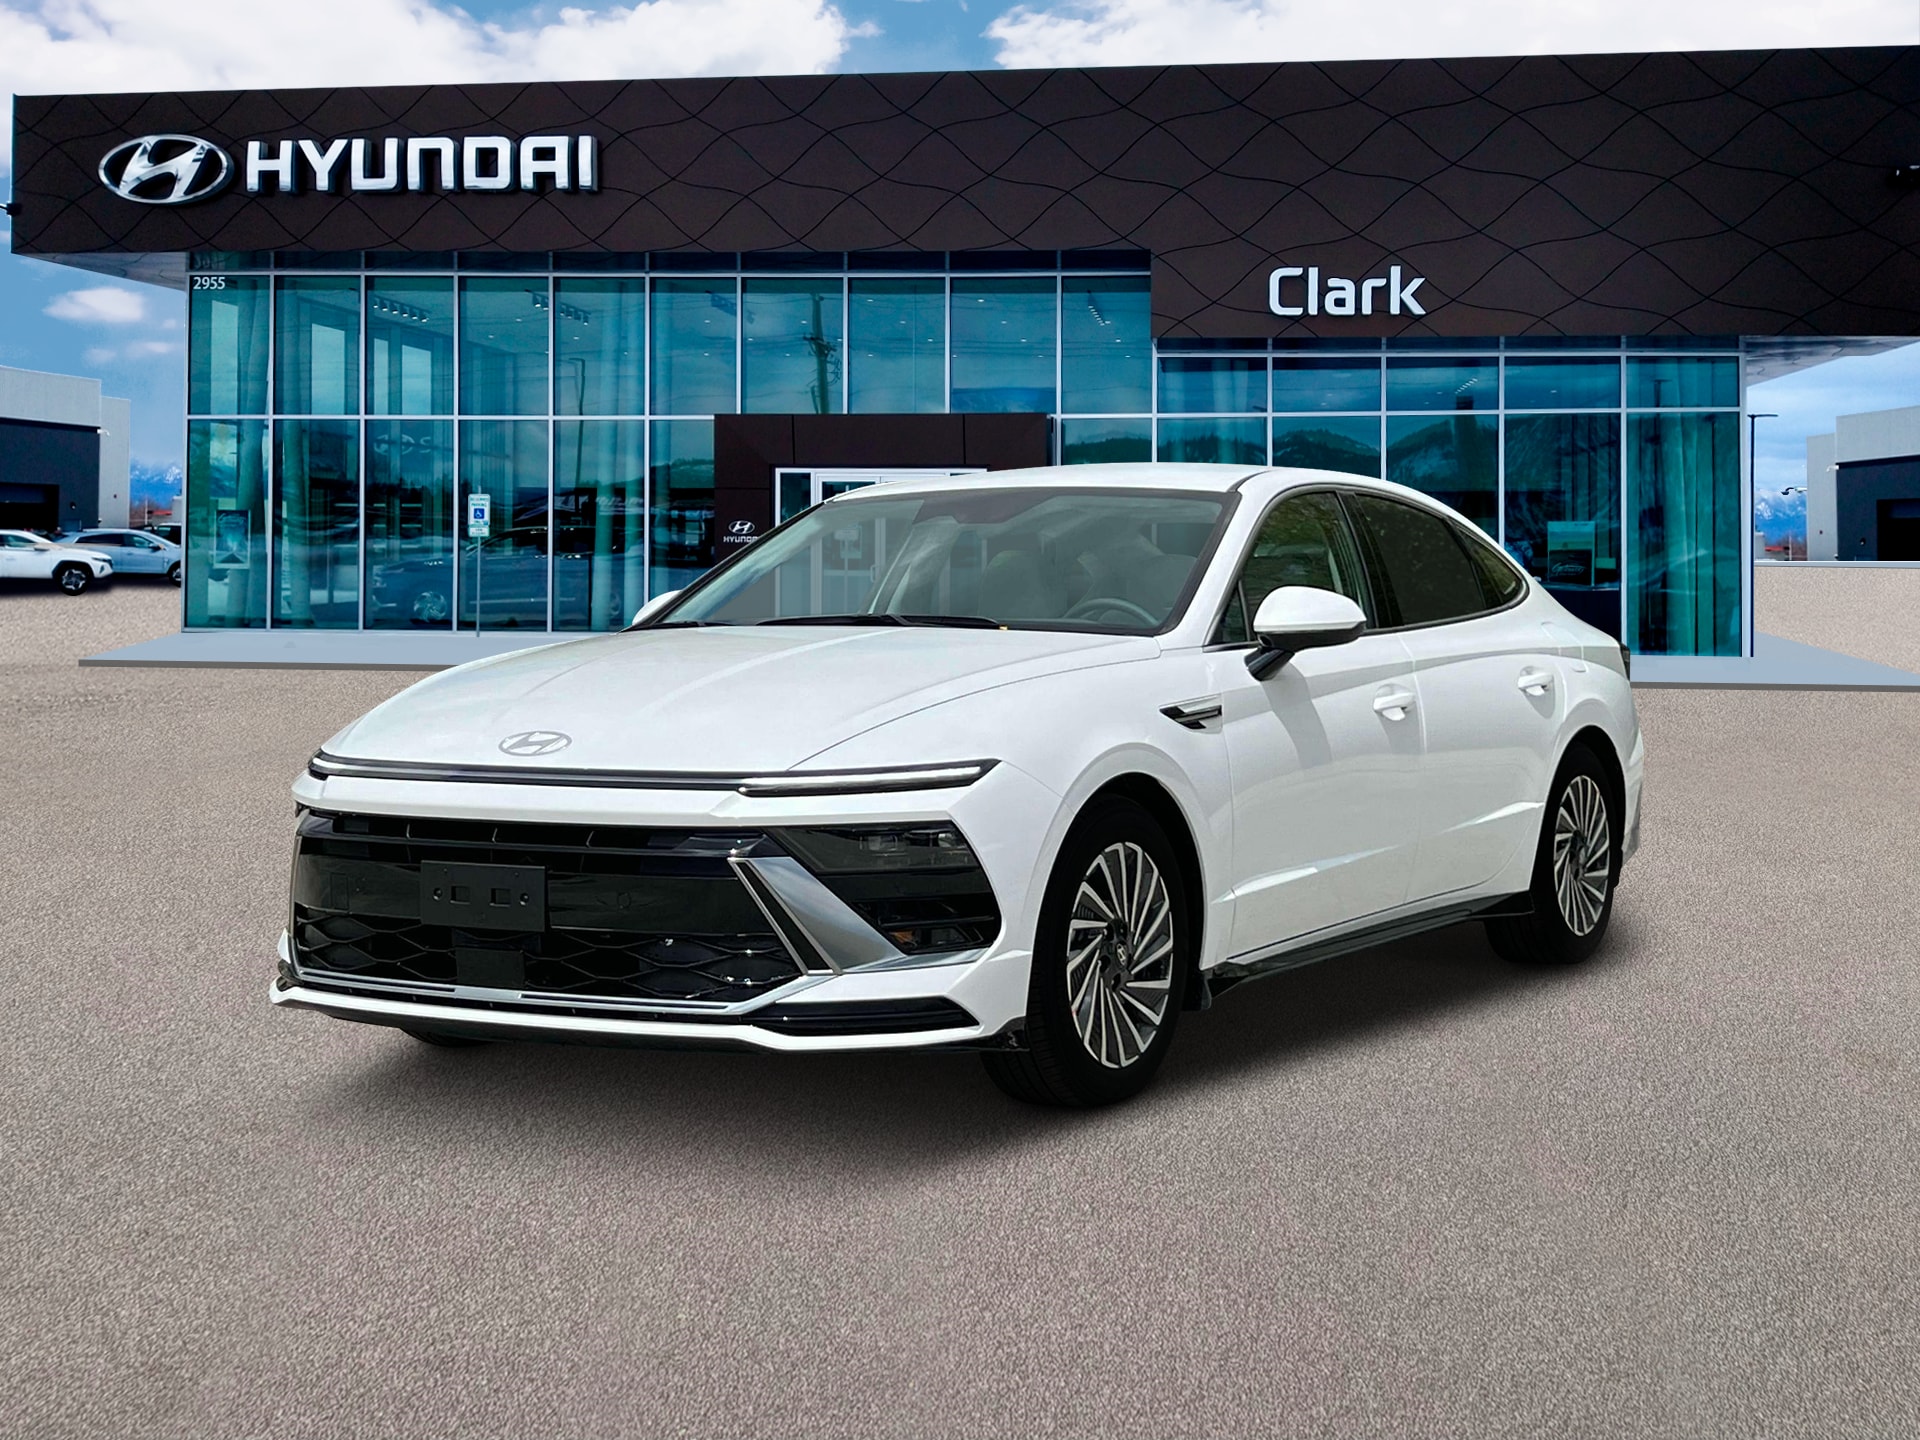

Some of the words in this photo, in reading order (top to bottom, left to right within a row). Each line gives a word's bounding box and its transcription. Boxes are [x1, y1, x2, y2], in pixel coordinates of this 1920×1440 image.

[246, 135, 596, 193] HYUNDAI
[193, 276, 226, 290] 2955
[1269, 265, 1427, 316] Clark
[723, 535, 759, 543] HYUND
